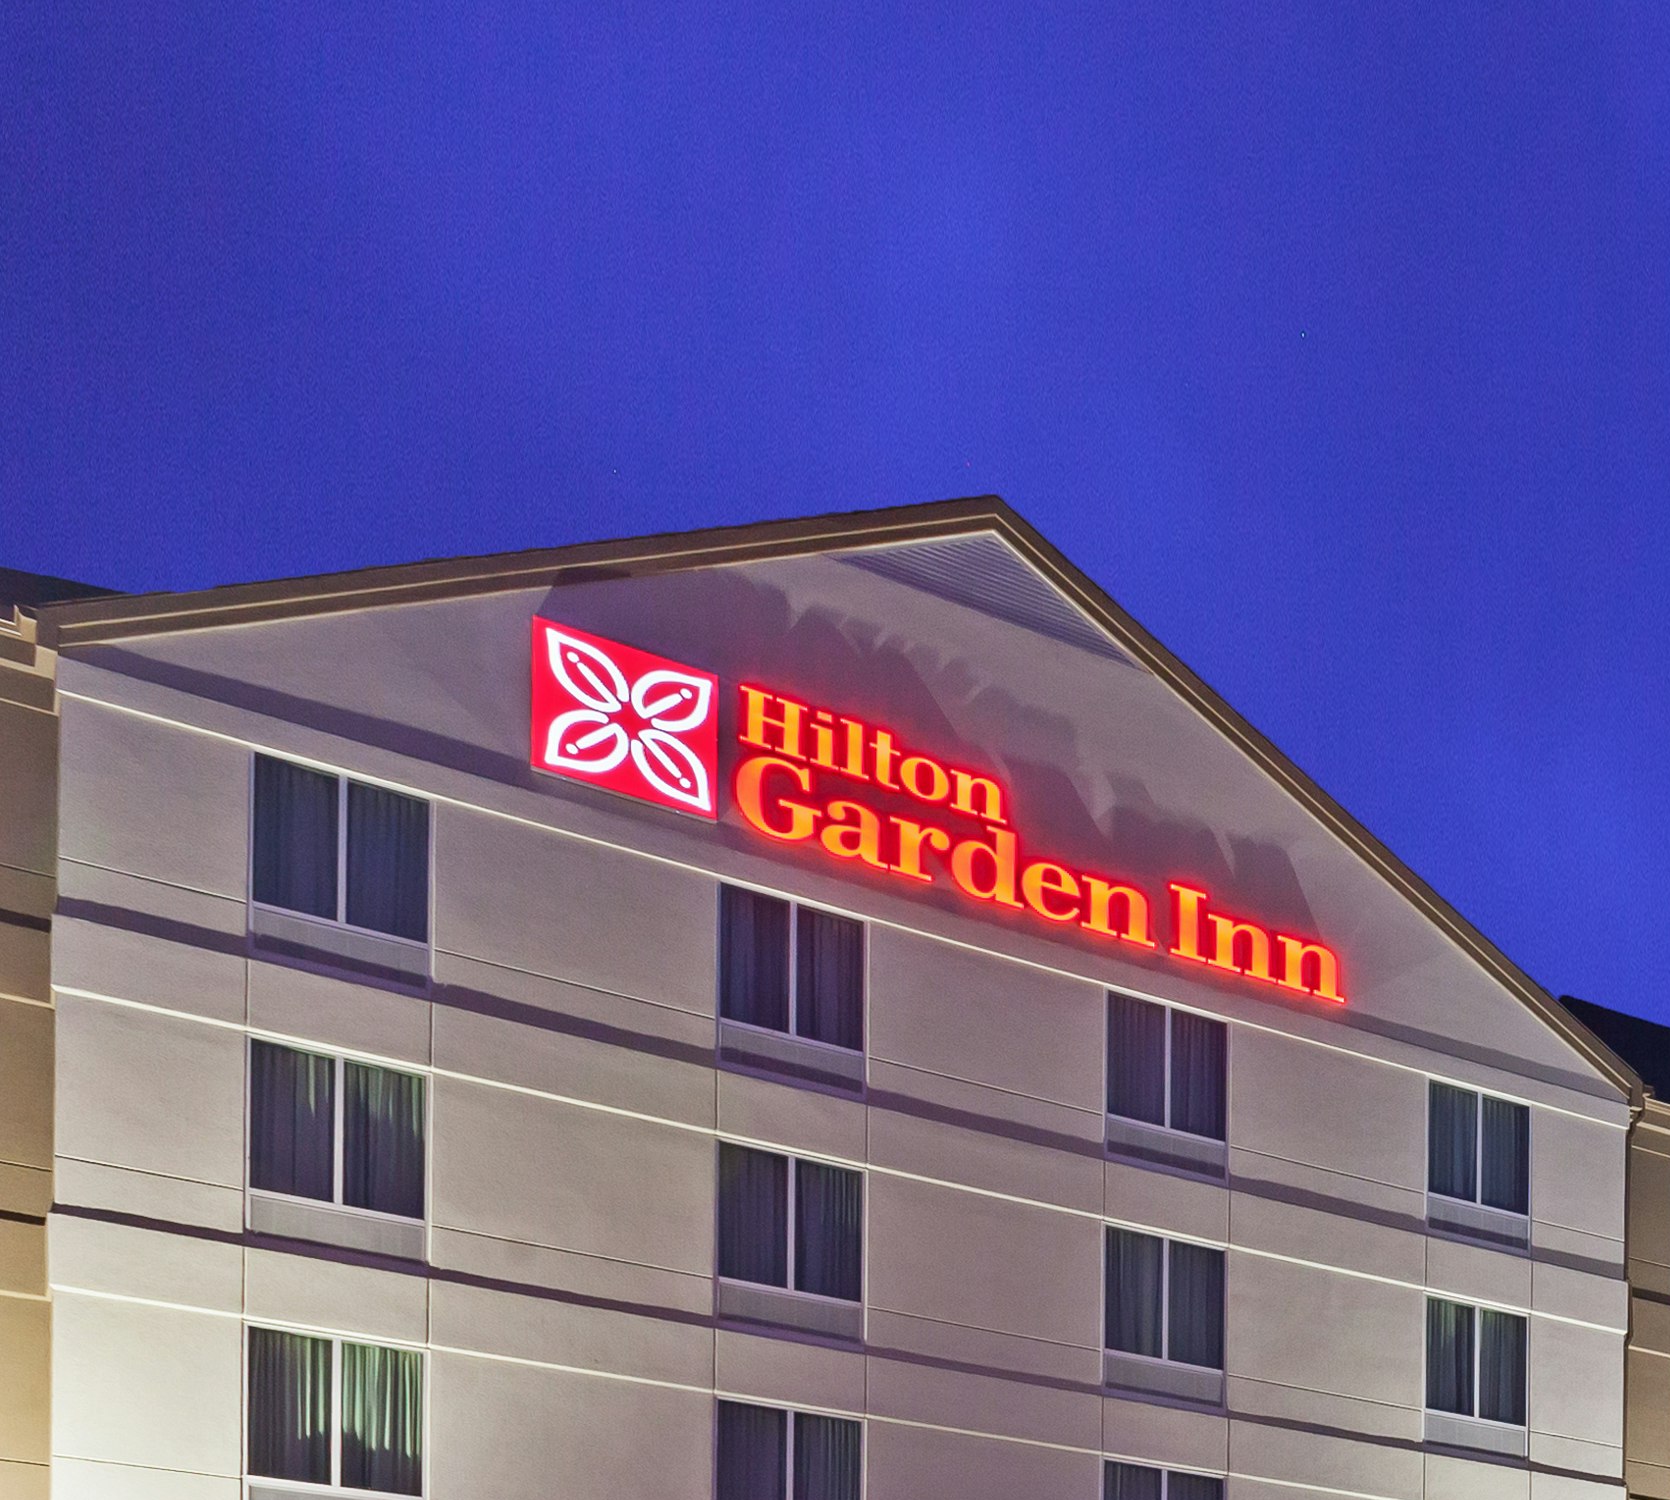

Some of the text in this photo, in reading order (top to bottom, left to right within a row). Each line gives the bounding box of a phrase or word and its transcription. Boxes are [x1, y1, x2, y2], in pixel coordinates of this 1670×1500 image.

[735, 683, 1008, 826] Hilton
[733, 755, 1346, 1004] Garden Inn
